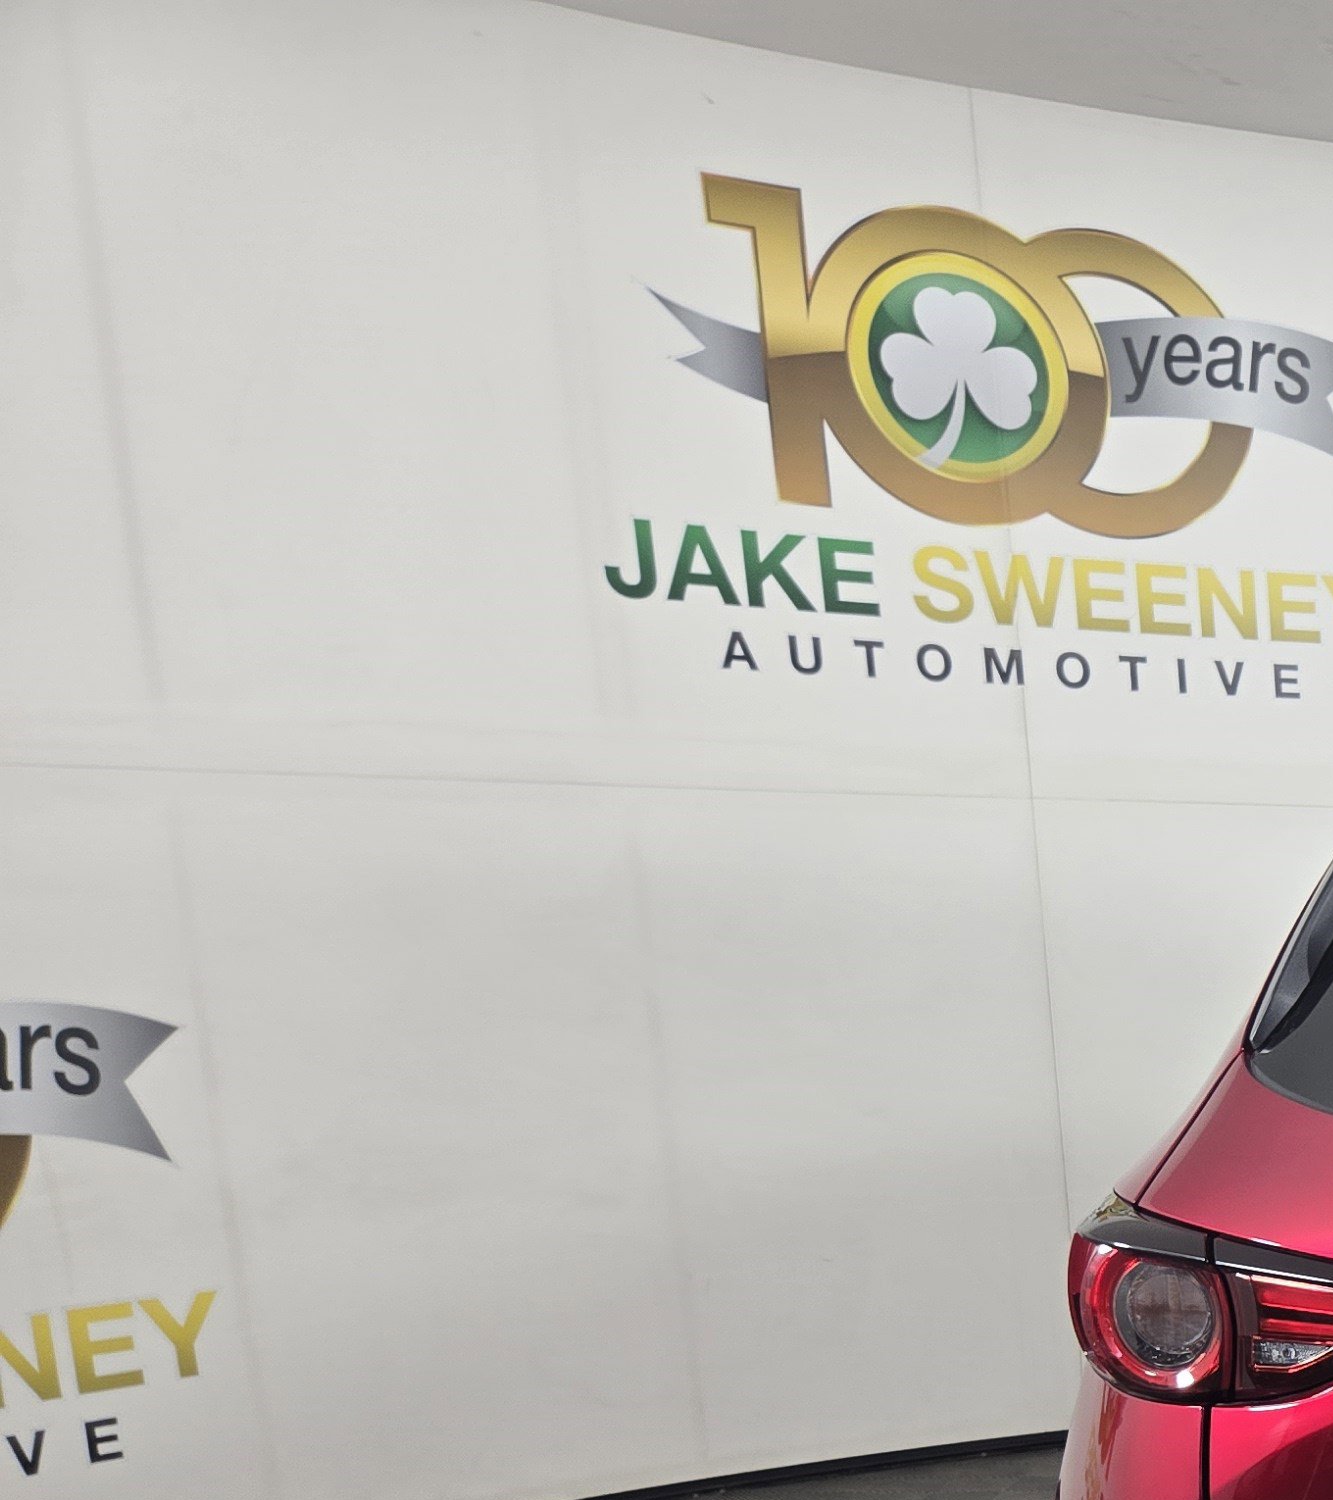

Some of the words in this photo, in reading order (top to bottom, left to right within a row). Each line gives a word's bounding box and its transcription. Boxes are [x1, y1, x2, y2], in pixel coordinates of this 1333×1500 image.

[700, 171, 1254, 539] 100
[1120, 331, 1313, 404] years
[604, 517, 882, 617] JAKE
[721, 630, 1304, 700] AUTOMOTIVE
